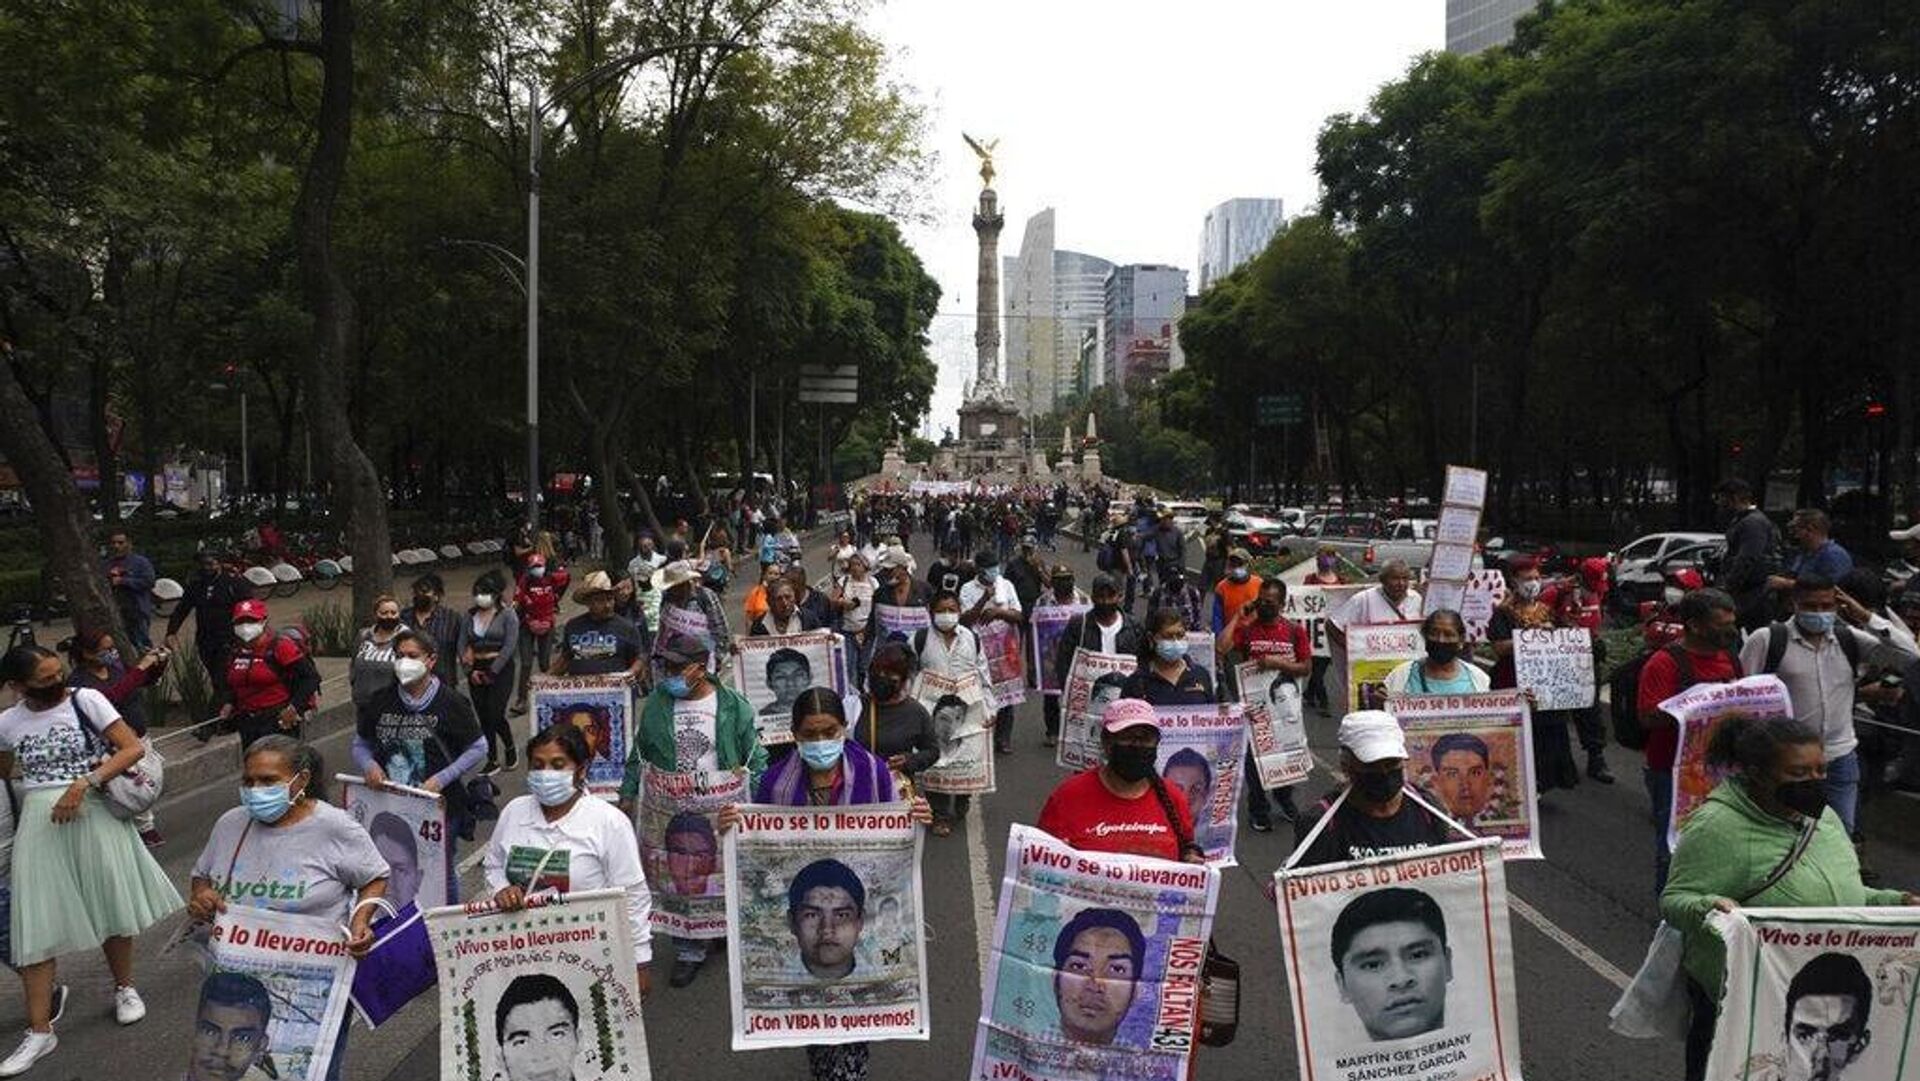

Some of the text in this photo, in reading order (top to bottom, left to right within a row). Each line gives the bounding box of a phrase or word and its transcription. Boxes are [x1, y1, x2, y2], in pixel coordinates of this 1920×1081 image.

[1430, 699, 1444, 710] se
[1447, 697, 1460, 709] lo
[1159, 717, 1174, 728] se
[1177, 715, 1189, 727] lo
[419, 820, 442, 842] 43
[739, 813, 912, 833] ¡Vivo se lo llevaron!
[1023, 845, 1071, 869] ¡Vivo
[1077, 858, 1100, 875] se
[1106, 864, 1123, 880] lo
[1129, 864, 1207, 890] llevaron!
[1290, 852, 1477, 900] ¡Vivo se lo llevaron!
[228, 924, 249, 945] lo
[254, 928, 348, 957] llevaron!
[455, 926, 596, 960] ¡Vivo se lo llevaron!
[1804, 932, 1821, 947] se
[1826, 930, 1842, 947] lo
[1845, 930, 1918, 948] llevaron!
[1169, 937, 1203, 970] NOS
[1160, 974, 1196, 1030] FALTAN
[750, 1009, 915, 1033] ¡Con VIDA lo queremos!
[1336, 1033, 1472, 1069] MARTÍN GETSEMANY
[1418, 1050, 1467, 1072] GARCÍA
